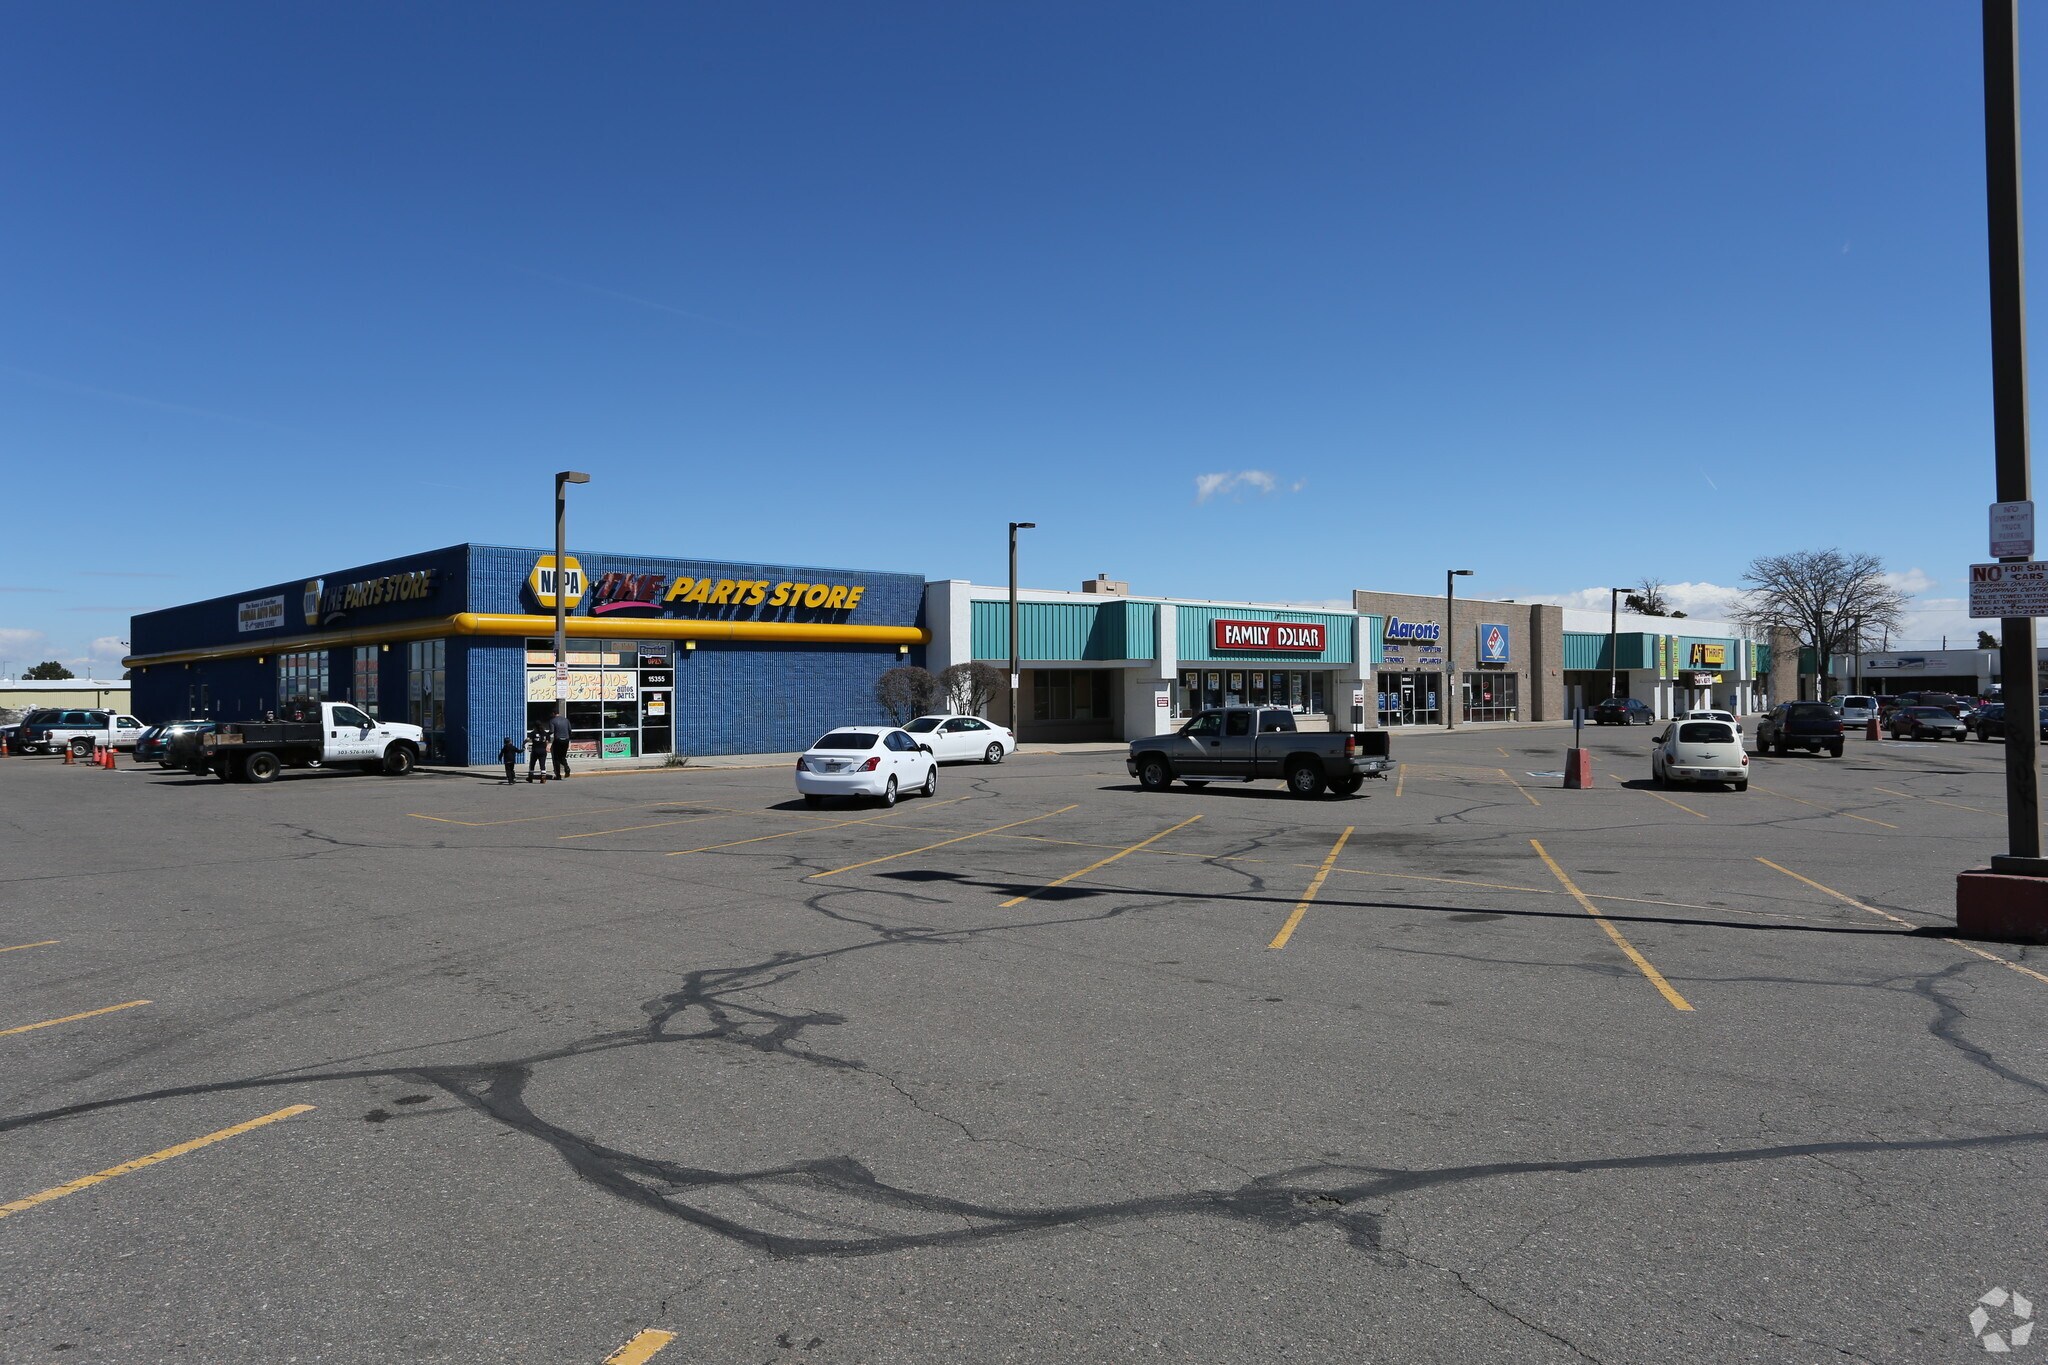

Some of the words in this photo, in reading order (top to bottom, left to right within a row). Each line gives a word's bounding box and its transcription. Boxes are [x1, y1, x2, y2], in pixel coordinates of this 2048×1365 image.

[2003, 505, 2019, 513] NO
[1973, 566, 2002, 582] NO
[2005, 565, 2023, 573] FOR
[2027, 564, 2048, 572] SAL
[2014, 572, 2044, 581] CARS
[323, 585, 347, 614] THE
[344, 576, 385, 610] PARTS
[384, 569, 432, 603] STORE
[540, 569, 580, 595] NPA
[596, 571, 666, 602] THE
[663, 576, 771, 607] PARTS
[768, 581, 866, 610] STORE
[2008, 603, 2048, 611] TOWIN
[1387, 616, 1441, 640] Aaron's
[1225, 625, 1270, 645] FAMILY
[1277, 627, 1320, 647] DOLLAR
[1705, 648, 1724, 659] THRIFT
[617, 685, 634, 693] autos
[616, 692, 635, 700] parts
